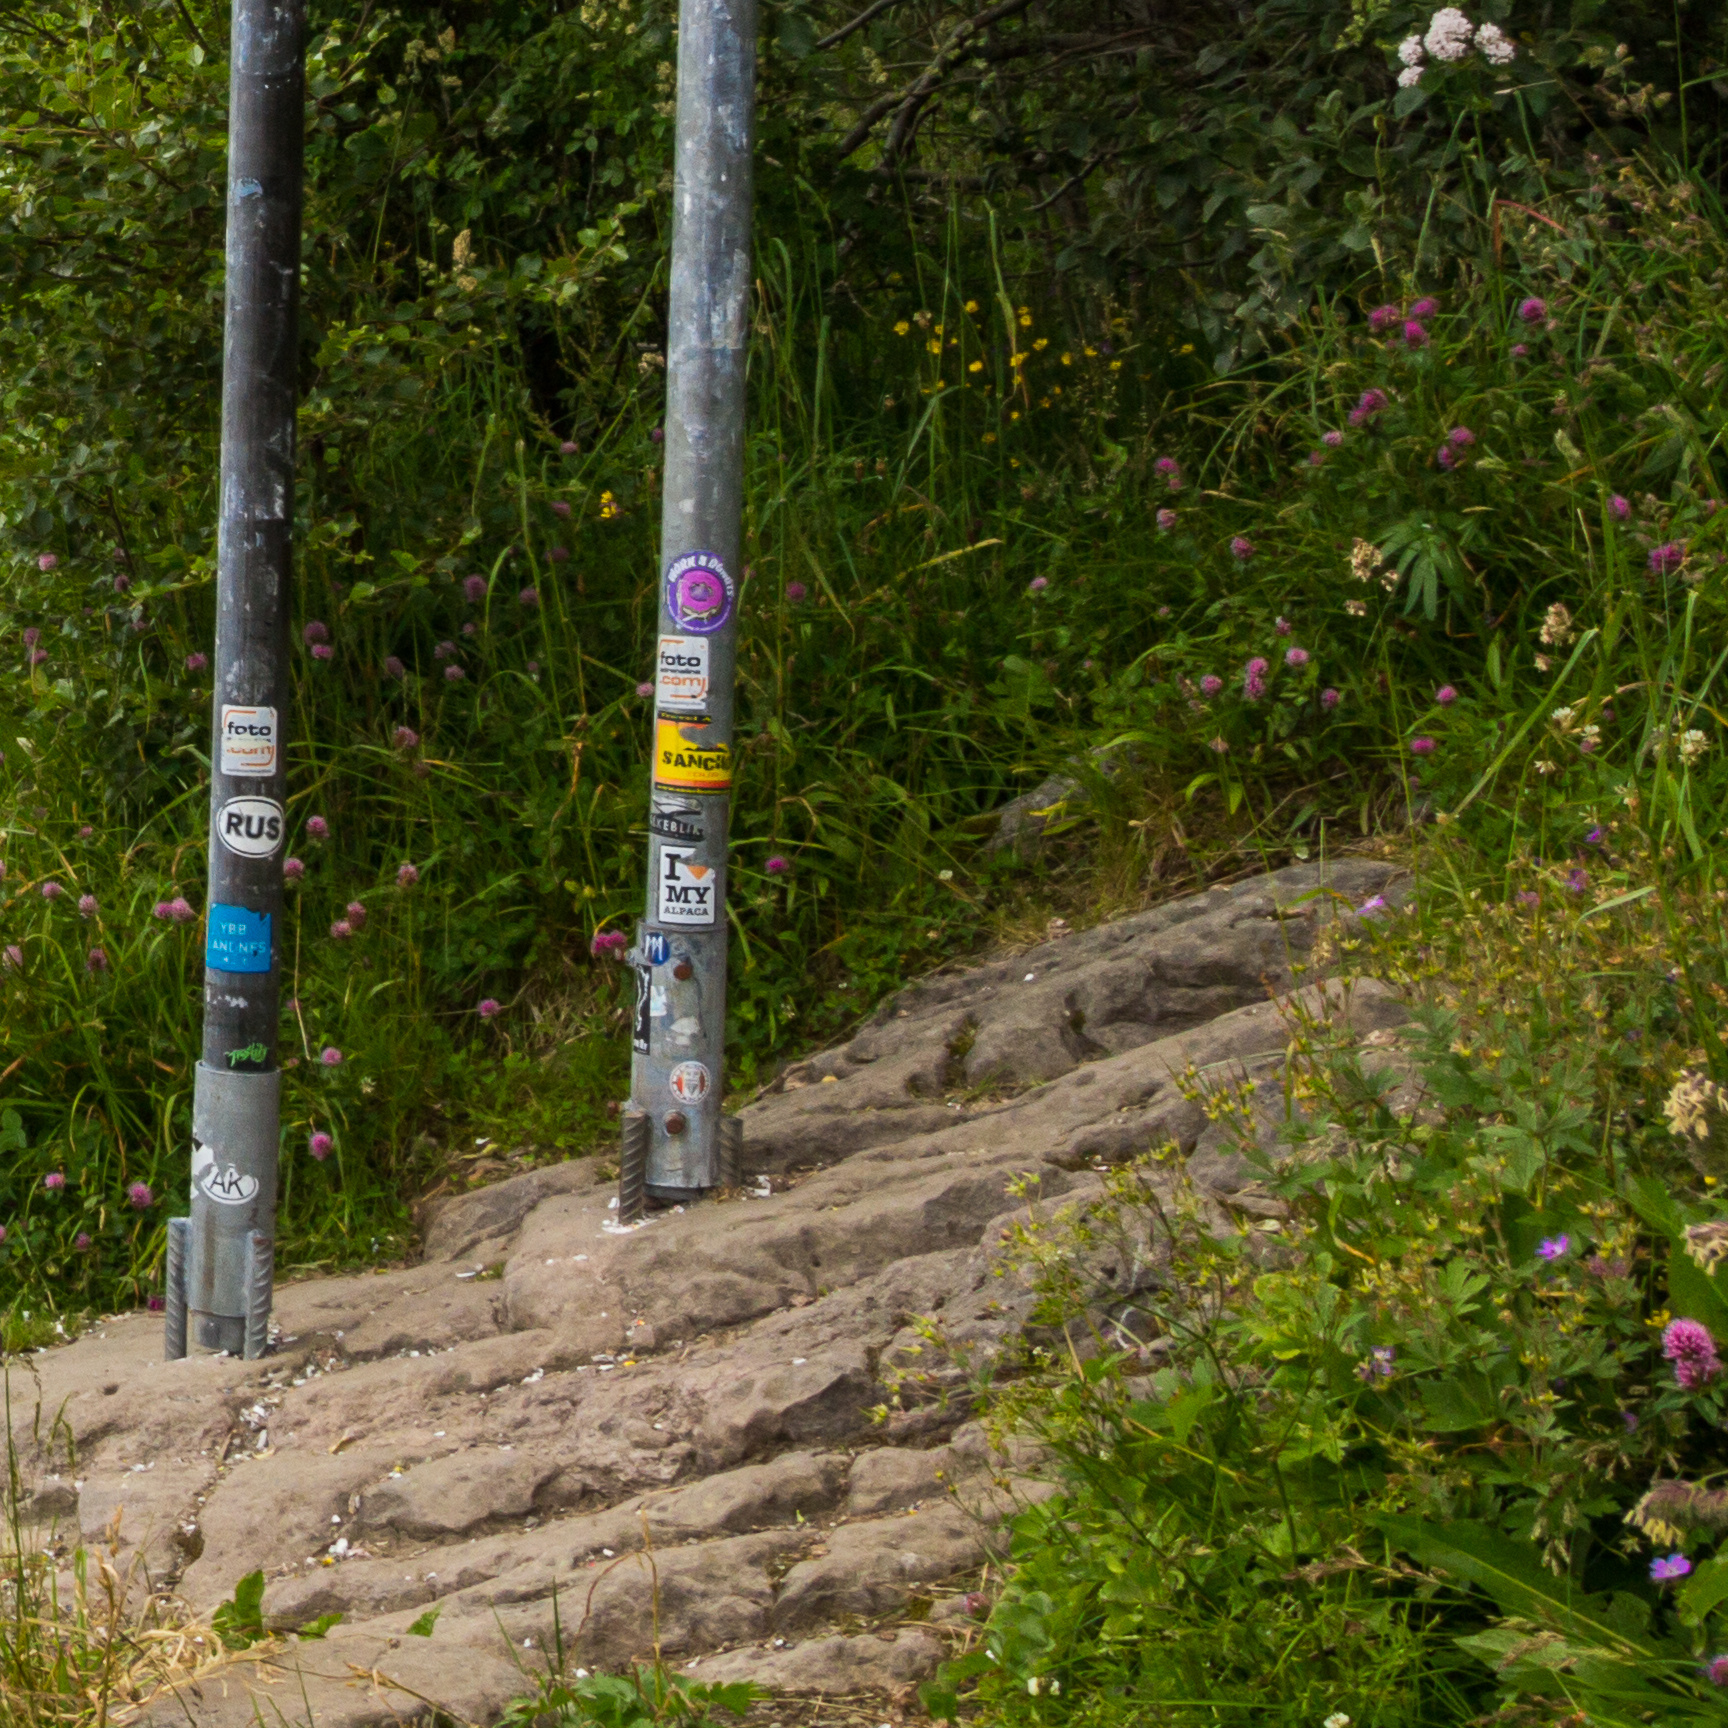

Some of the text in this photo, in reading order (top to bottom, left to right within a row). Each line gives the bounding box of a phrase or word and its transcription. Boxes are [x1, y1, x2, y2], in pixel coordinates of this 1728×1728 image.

[660, 651, 701, 667] foto
[660, 675, 701, 687] .com
[227, 721, 272, 736] foto
[225, 812, 280, 841] RUS
[664, 853, 681, 881] I
[665, 885, 710, 904] MY
[664, 906, 709, 916] ALPACA
